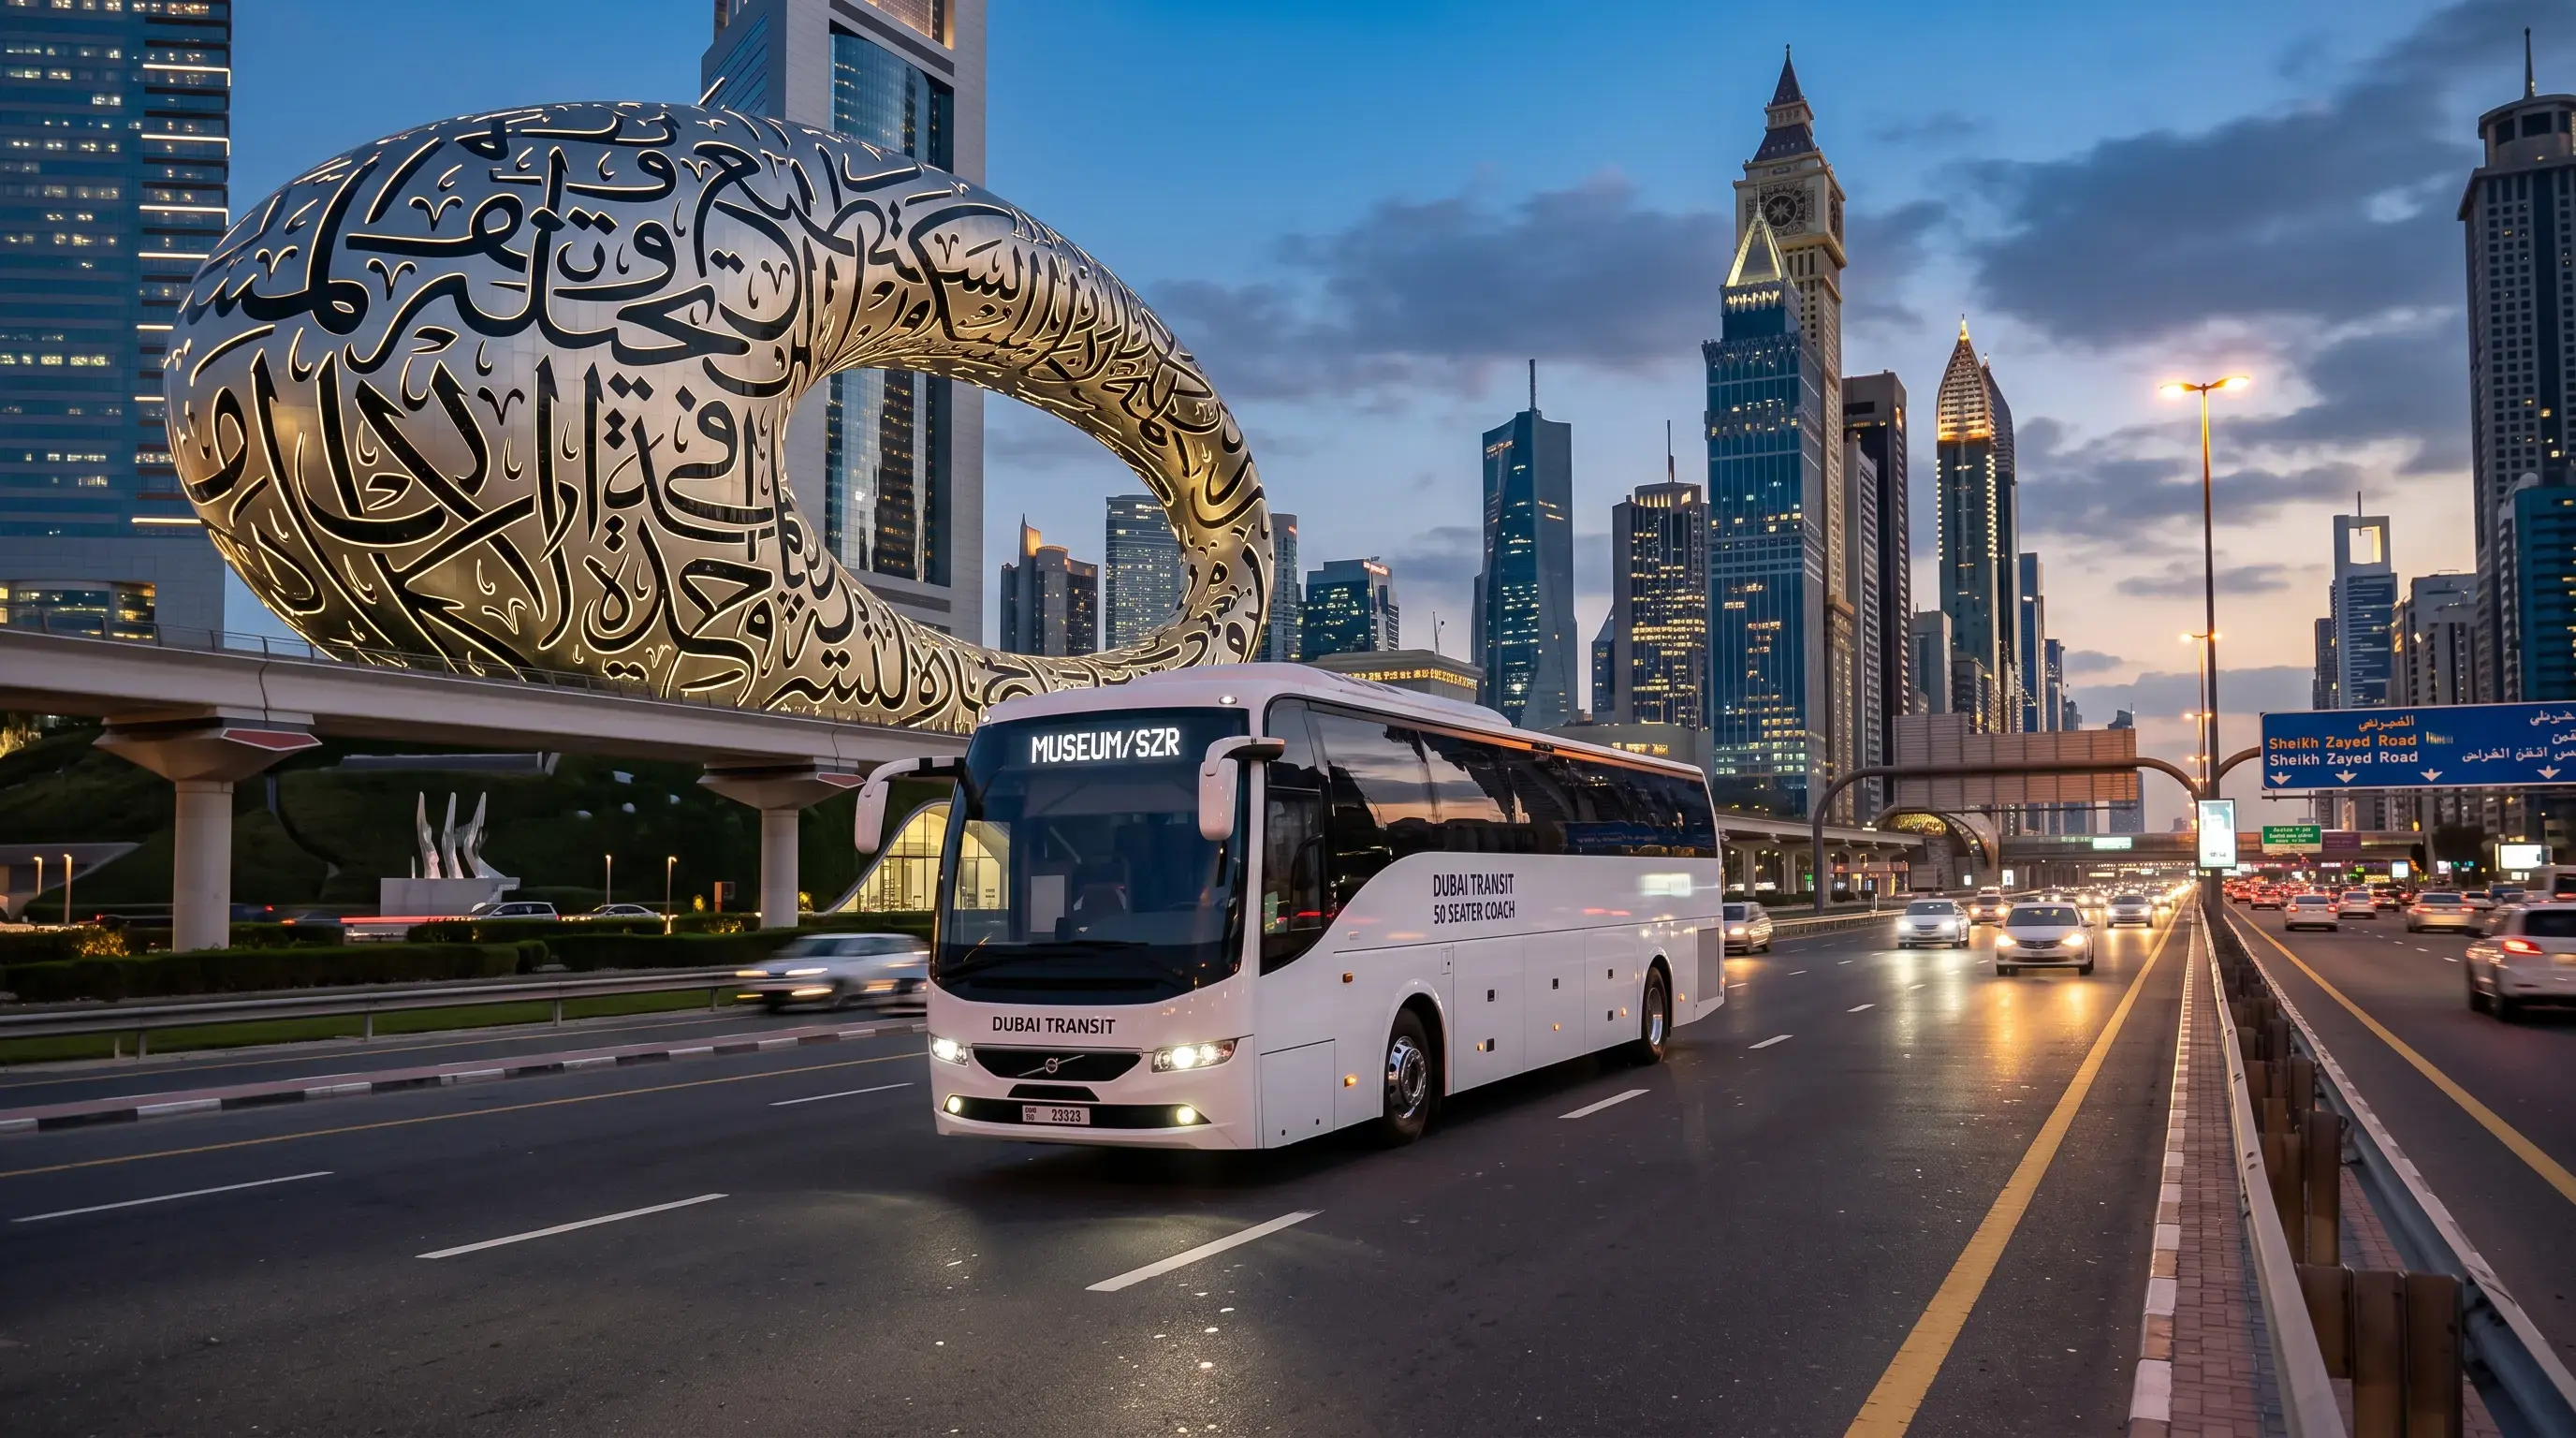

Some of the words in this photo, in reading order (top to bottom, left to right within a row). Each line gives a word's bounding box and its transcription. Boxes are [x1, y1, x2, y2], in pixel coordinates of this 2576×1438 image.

[1031, 726, 1179, 764] MUSEUM/SZR
[2269, 737, 2319, 749] Sheikh
[2325, 736, 2370, 750] Zayed
[2378, 734, 2417, 747] Road
[2269, 753, 2320, 766] Sheikh
[2326, 752, 2372, 767] Zayed
[2379, 751, 2419, 763] Road
[1433, 873, 1469, 898] DUBAI
[1471, 873, 1515, 896] TRANSIT
[1434, 903, 1446, 925] 50
[1448, 902, 1483, 923] SEATER
[1485, 900, 1515, 920] COACH
[992, 1016, 1040, 1034] DUBAI
[1046, 1018, 1116, 1034] TRANSIT
[1051, 1108, 1081, 1123] 23323
